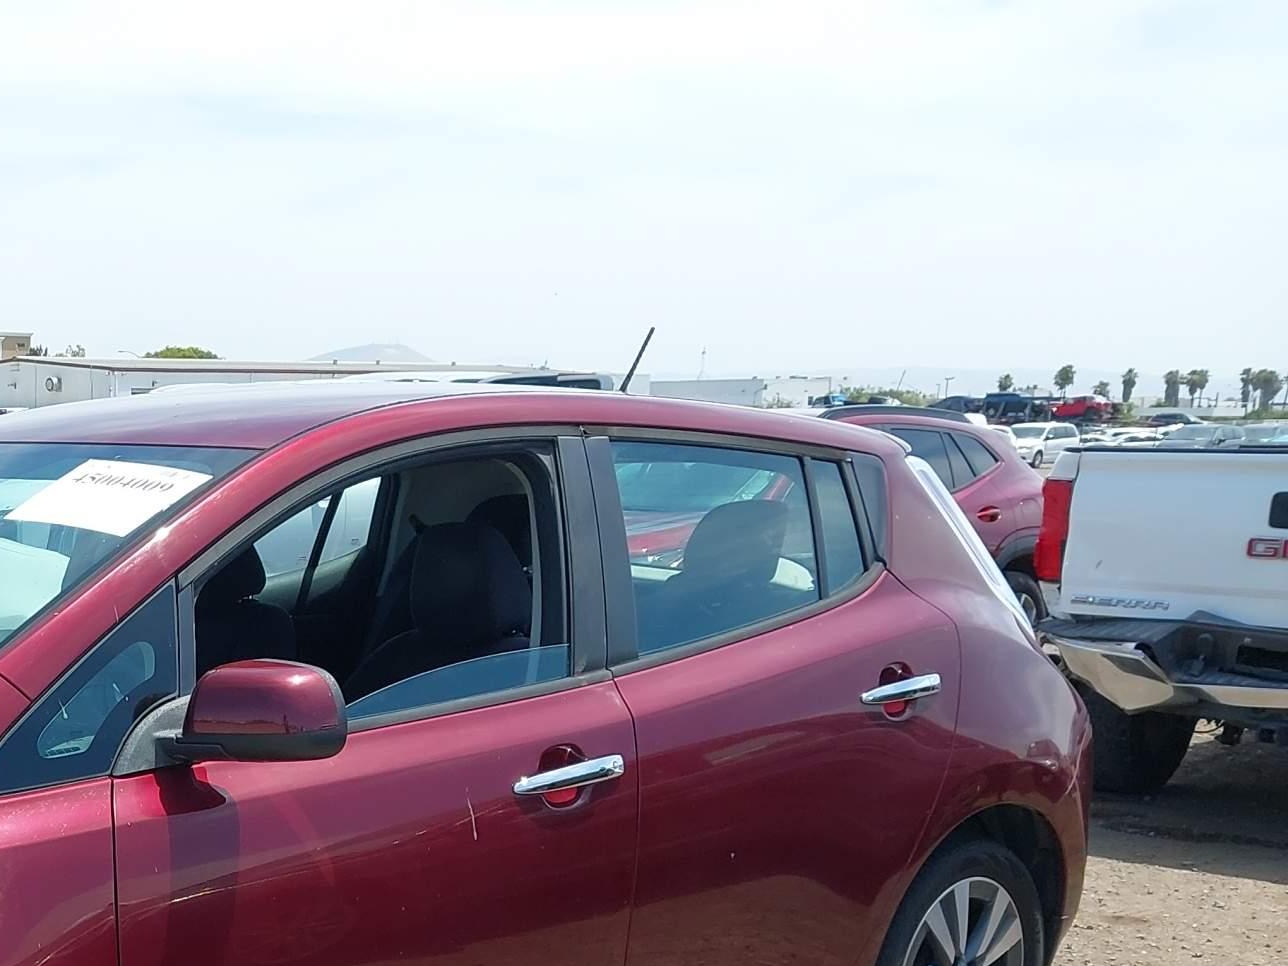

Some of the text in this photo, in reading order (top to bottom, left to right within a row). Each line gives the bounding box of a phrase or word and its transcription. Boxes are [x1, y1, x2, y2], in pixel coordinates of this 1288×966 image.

[72, 473, 175, 493] 45004009
[1246, 537, 1288, 559] G
[1071, 596, 1169, 610] SIERRA
